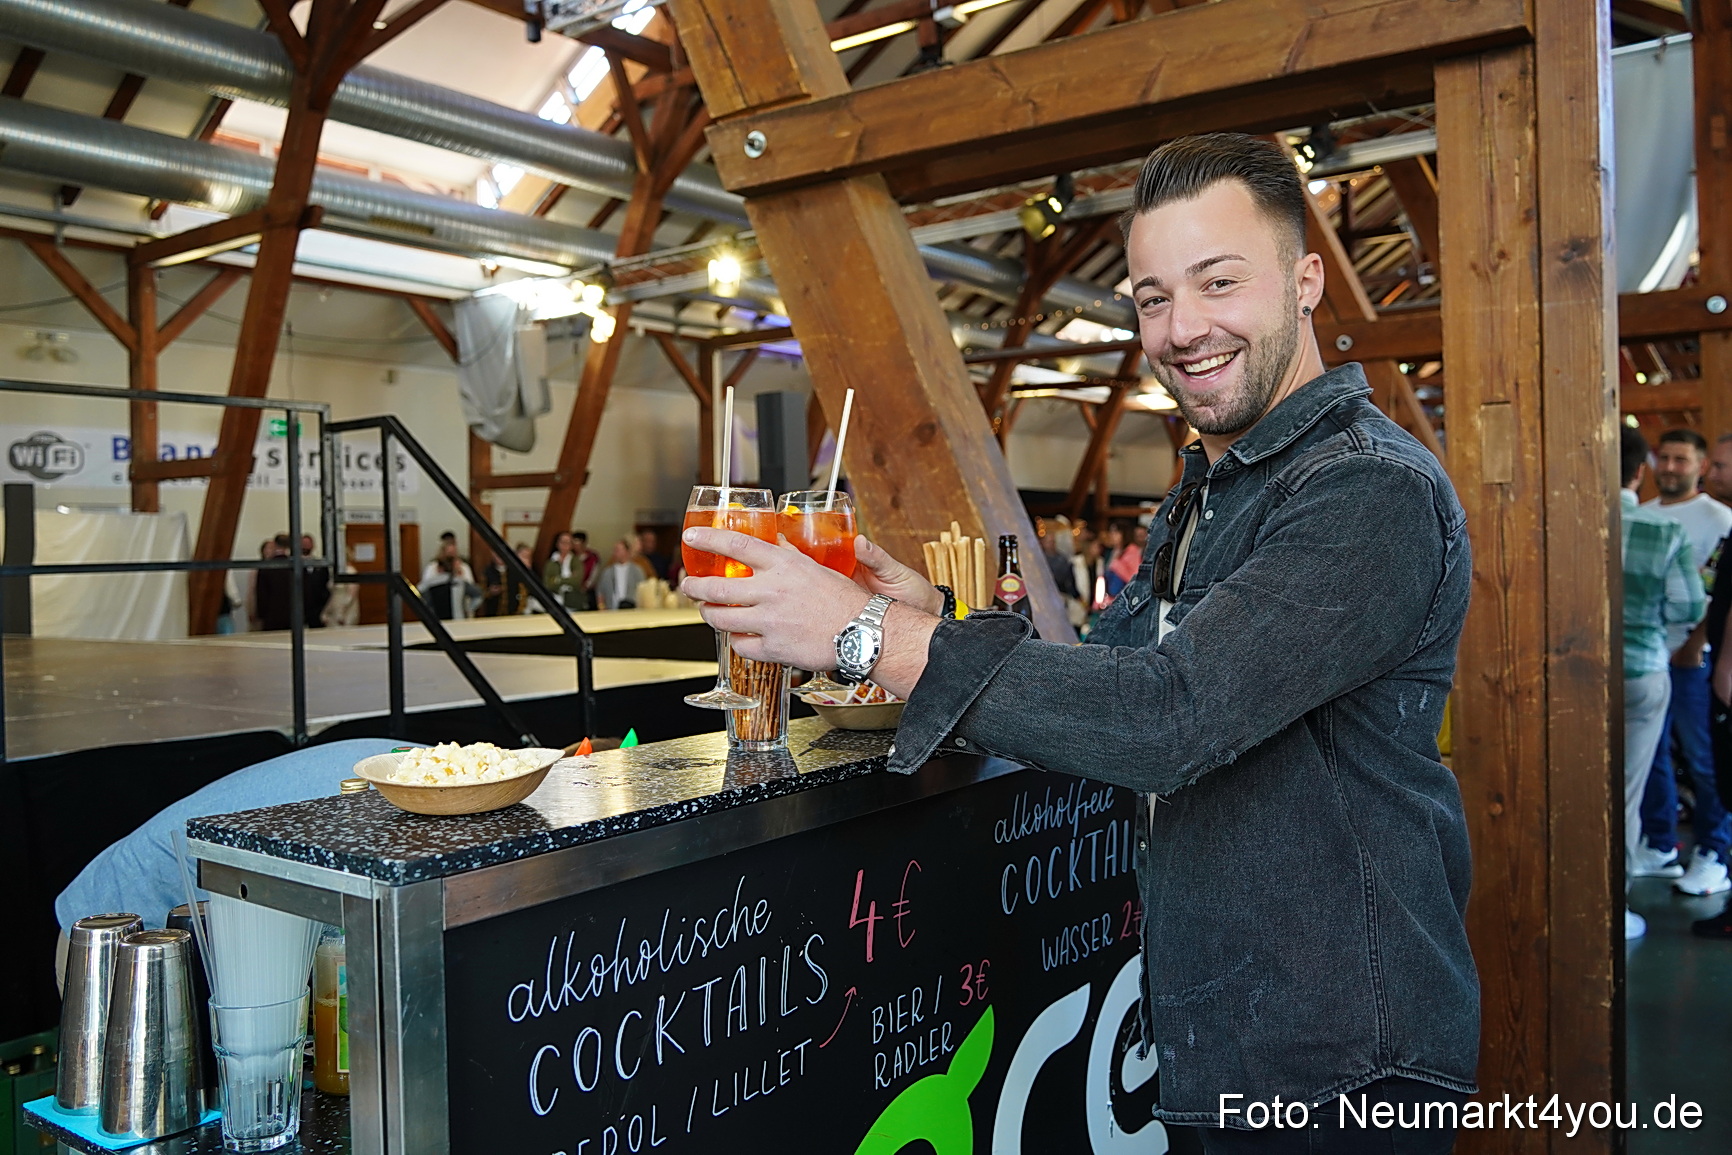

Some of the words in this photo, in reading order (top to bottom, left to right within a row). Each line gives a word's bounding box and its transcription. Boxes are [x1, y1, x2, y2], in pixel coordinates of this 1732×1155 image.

[994, 778, 1115, 844] alkoholfreie
[1000, 819, 1136, 915] COCKTAI
[507, 875, 772, 1023] alkoholische
[1041, 912, 1114, 972] WASSER
[959, 959, 991, 1006] 3€
[529, 933, 829, 1117] COCKTAILS
[874, 1021, 955, 1090] RADLER
[711, 1038, 813, 1117] LILLET
